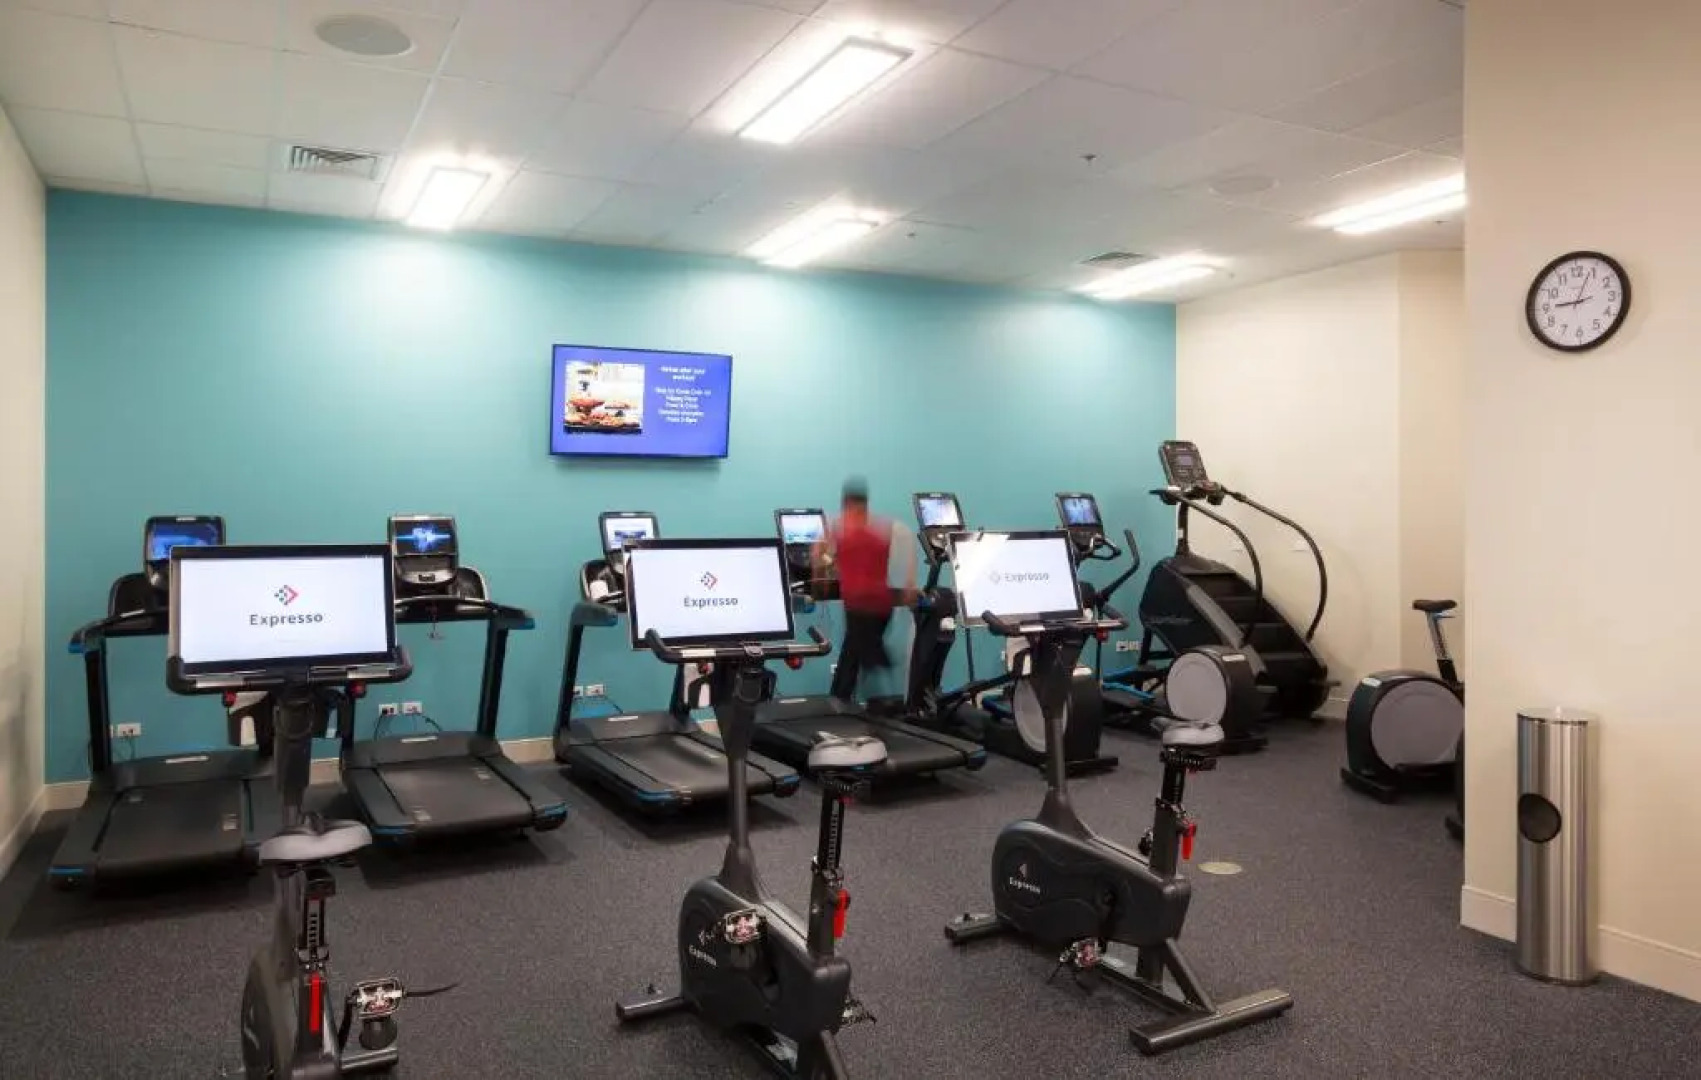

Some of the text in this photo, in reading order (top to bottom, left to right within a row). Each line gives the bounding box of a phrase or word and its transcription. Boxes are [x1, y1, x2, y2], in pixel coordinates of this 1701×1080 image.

[1571, 265, 1583, 278] 12
[1559, 273, 1567, 286] 11
[1602, 276, 1610, 288] 2
[1548, 287, 1559, 299] 10
[1608, 290, 1616, 302] 3
[1542, 303, 1550, 315] 9
[1602, 305, 1611, 317] 4
[1547, 315, 1556, 327] 8
[1592, 318, 1601, 330] 5
[1560, 323, 1568, 335] 7
[1576, 326, 1584, 337] 6
[683, 596, 739, 610] Expresso
[249, 613, 323, 628] Expresso
